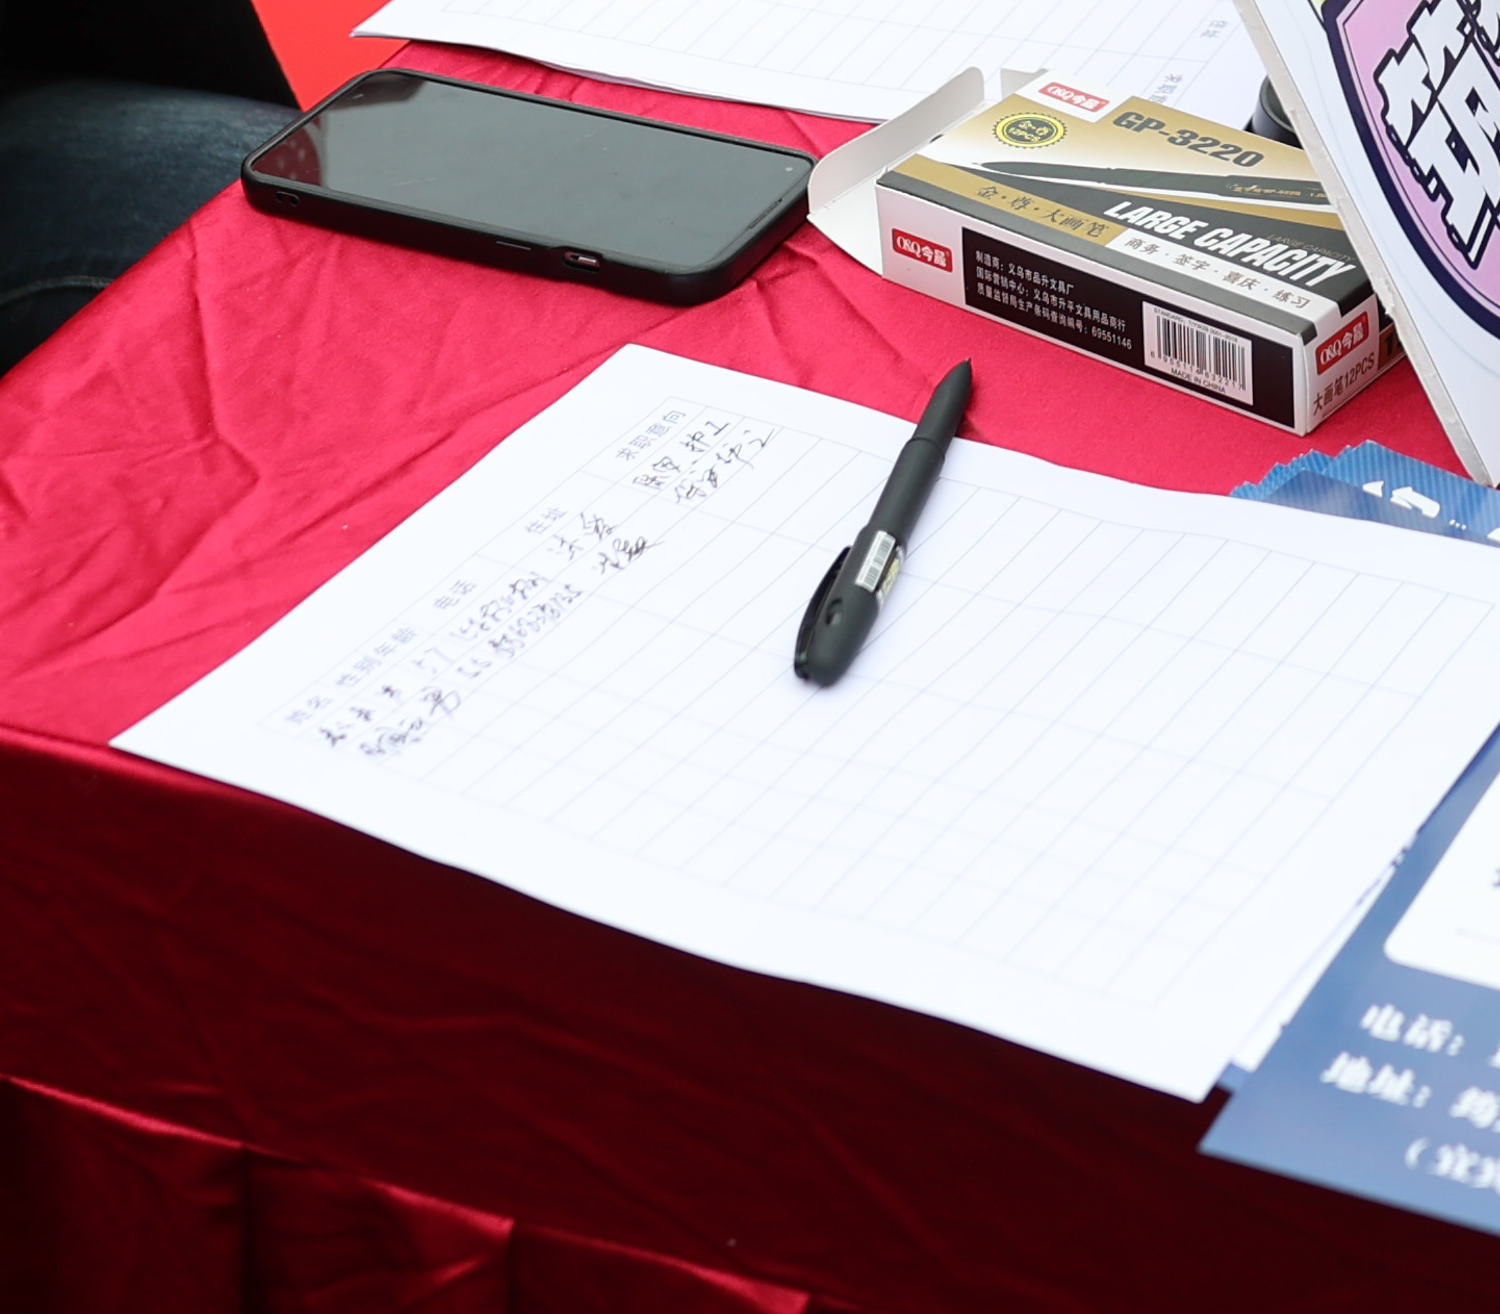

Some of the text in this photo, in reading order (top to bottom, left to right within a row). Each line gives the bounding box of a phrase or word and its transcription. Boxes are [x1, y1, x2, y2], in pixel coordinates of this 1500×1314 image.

[1112, 111, 1265, 168] GP-3220
[1104, 201, 1357, 288] LARGE CAPACITY
[1170, 367, 1193, 383] MADE
[1200, 378, 1227, 394] CHINA
[615, 410, 687, 461] 求职意向
